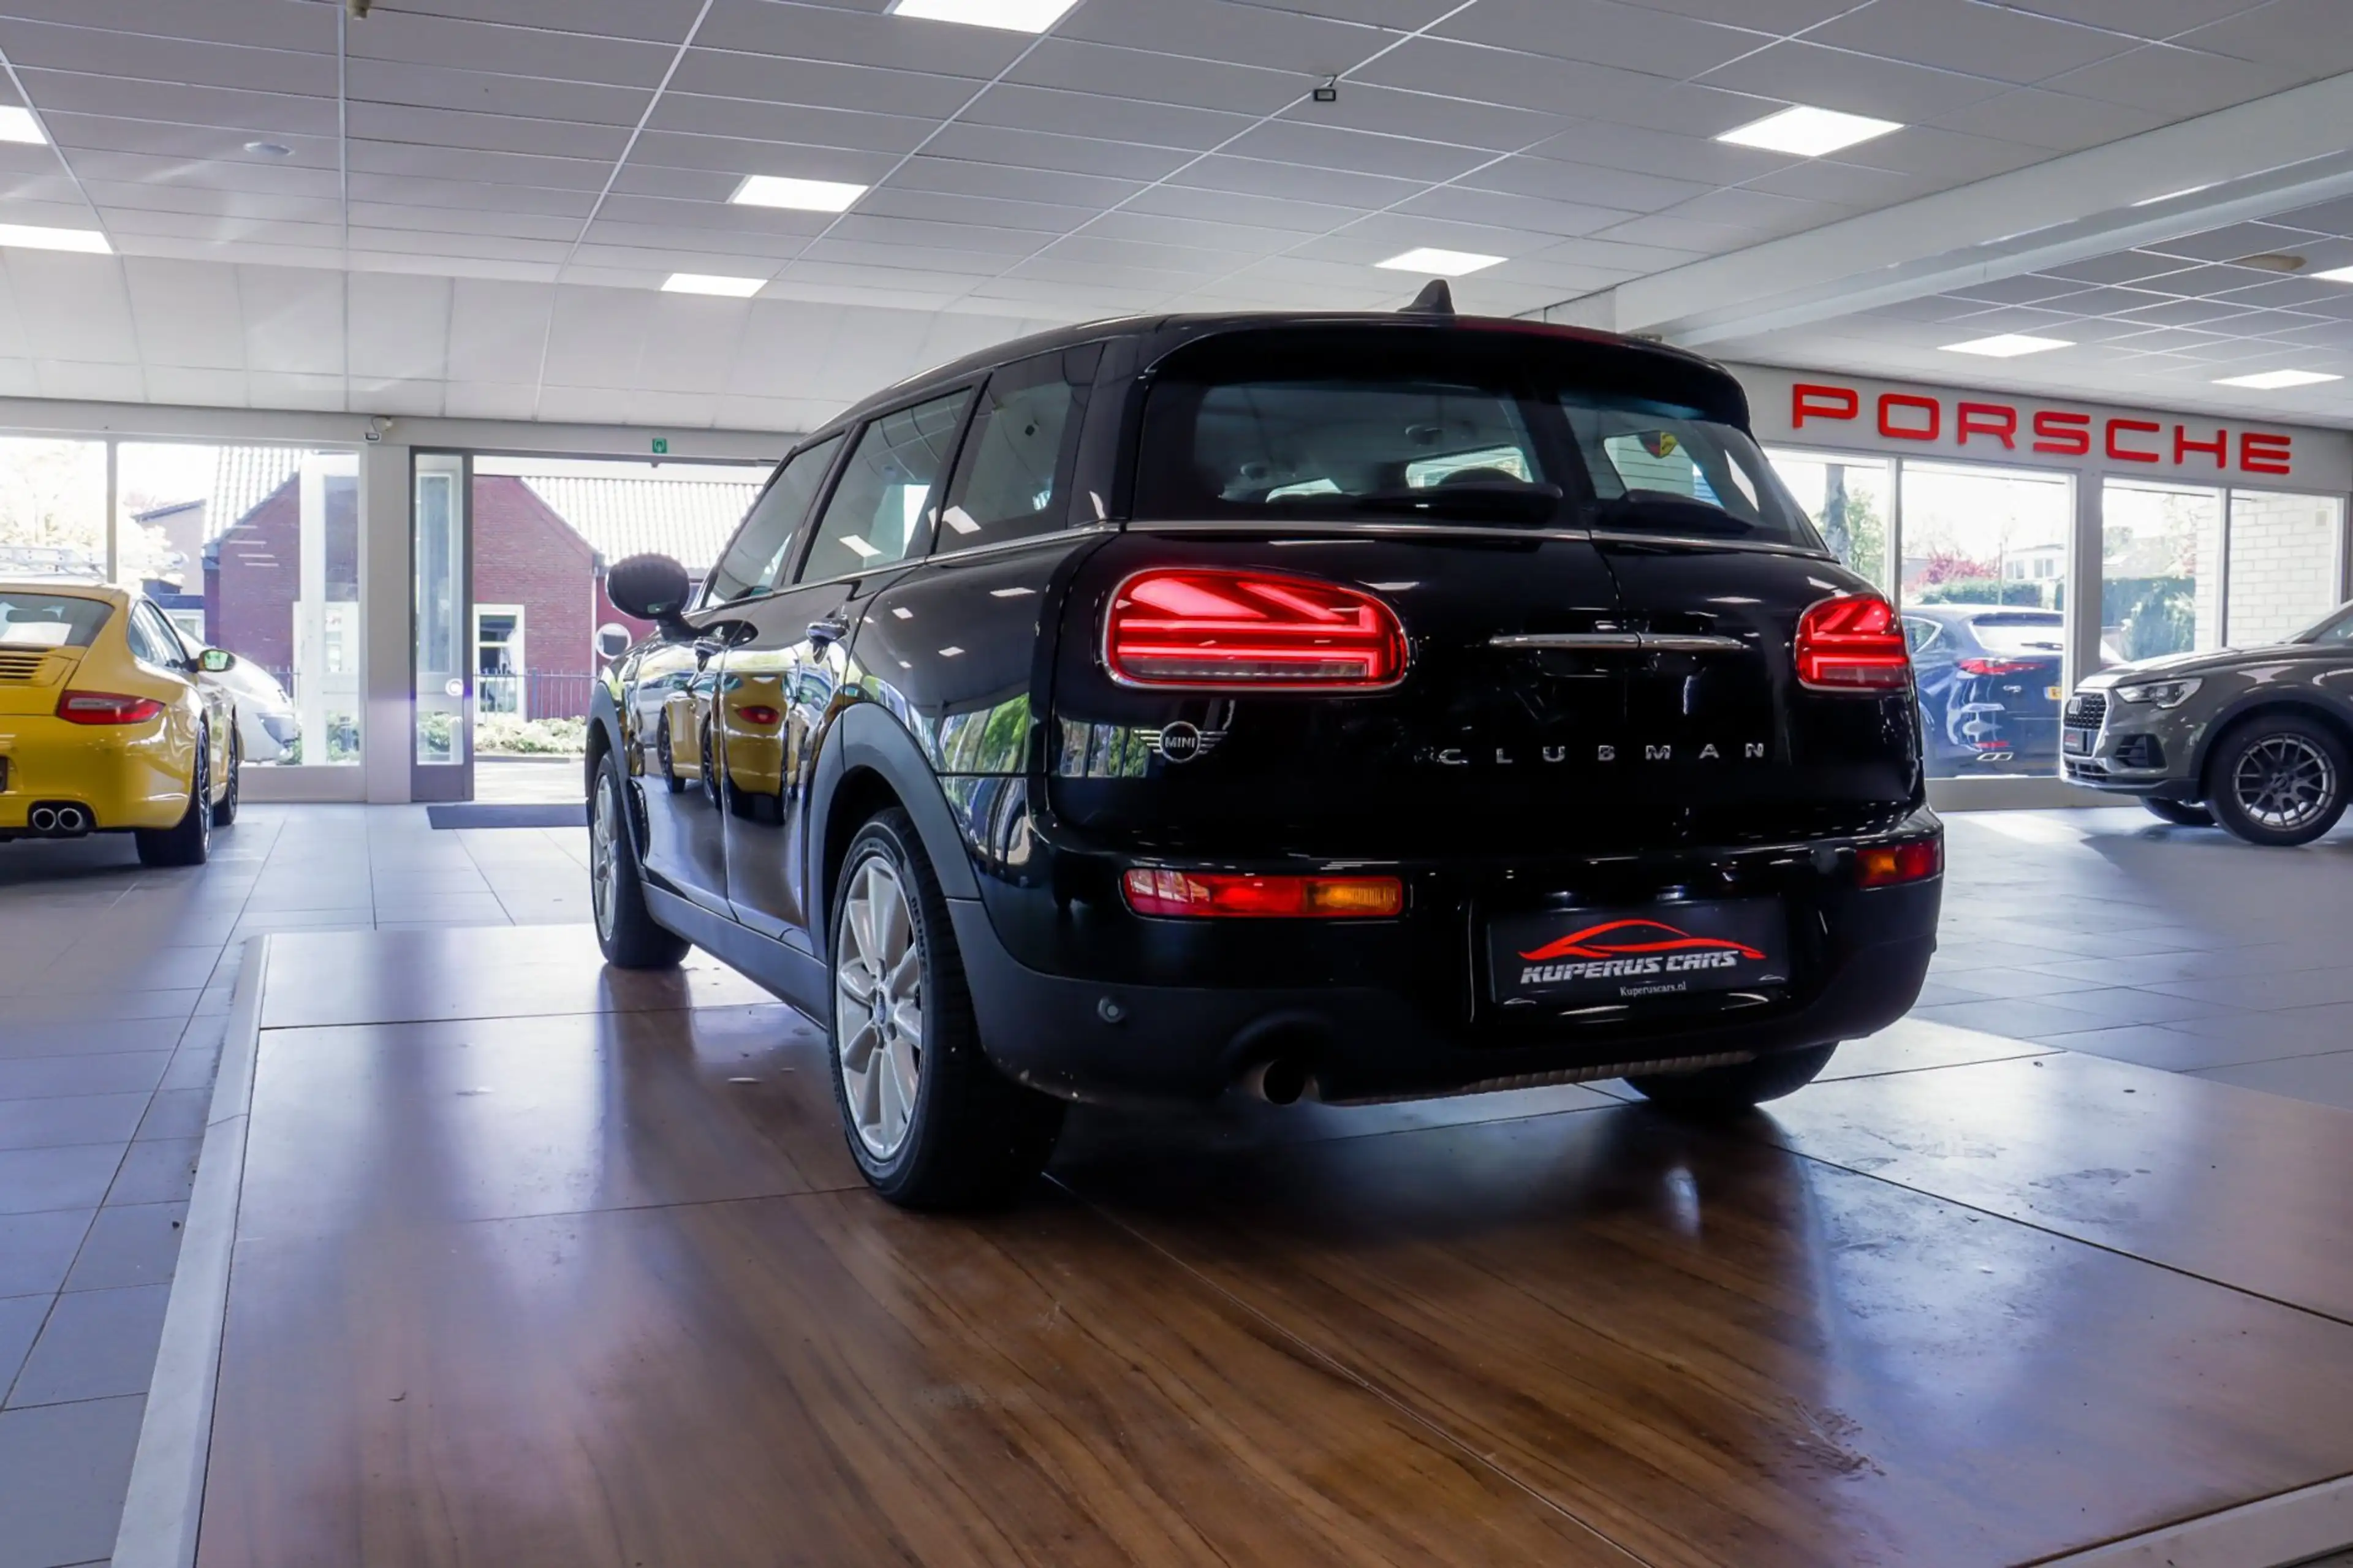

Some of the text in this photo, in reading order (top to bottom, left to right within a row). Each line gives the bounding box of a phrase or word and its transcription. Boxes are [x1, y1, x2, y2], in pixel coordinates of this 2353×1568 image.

[1792, 383, 2291, 474] PORSCHE
[1165, 736, 1195, 748] MINI
[1439, 742, 1764, 765] CLUBMAN
[1520, 950, 1739, 983] KUPERUS CARS
[1620, 982, 1686, 998] Kuperuscars.nl
